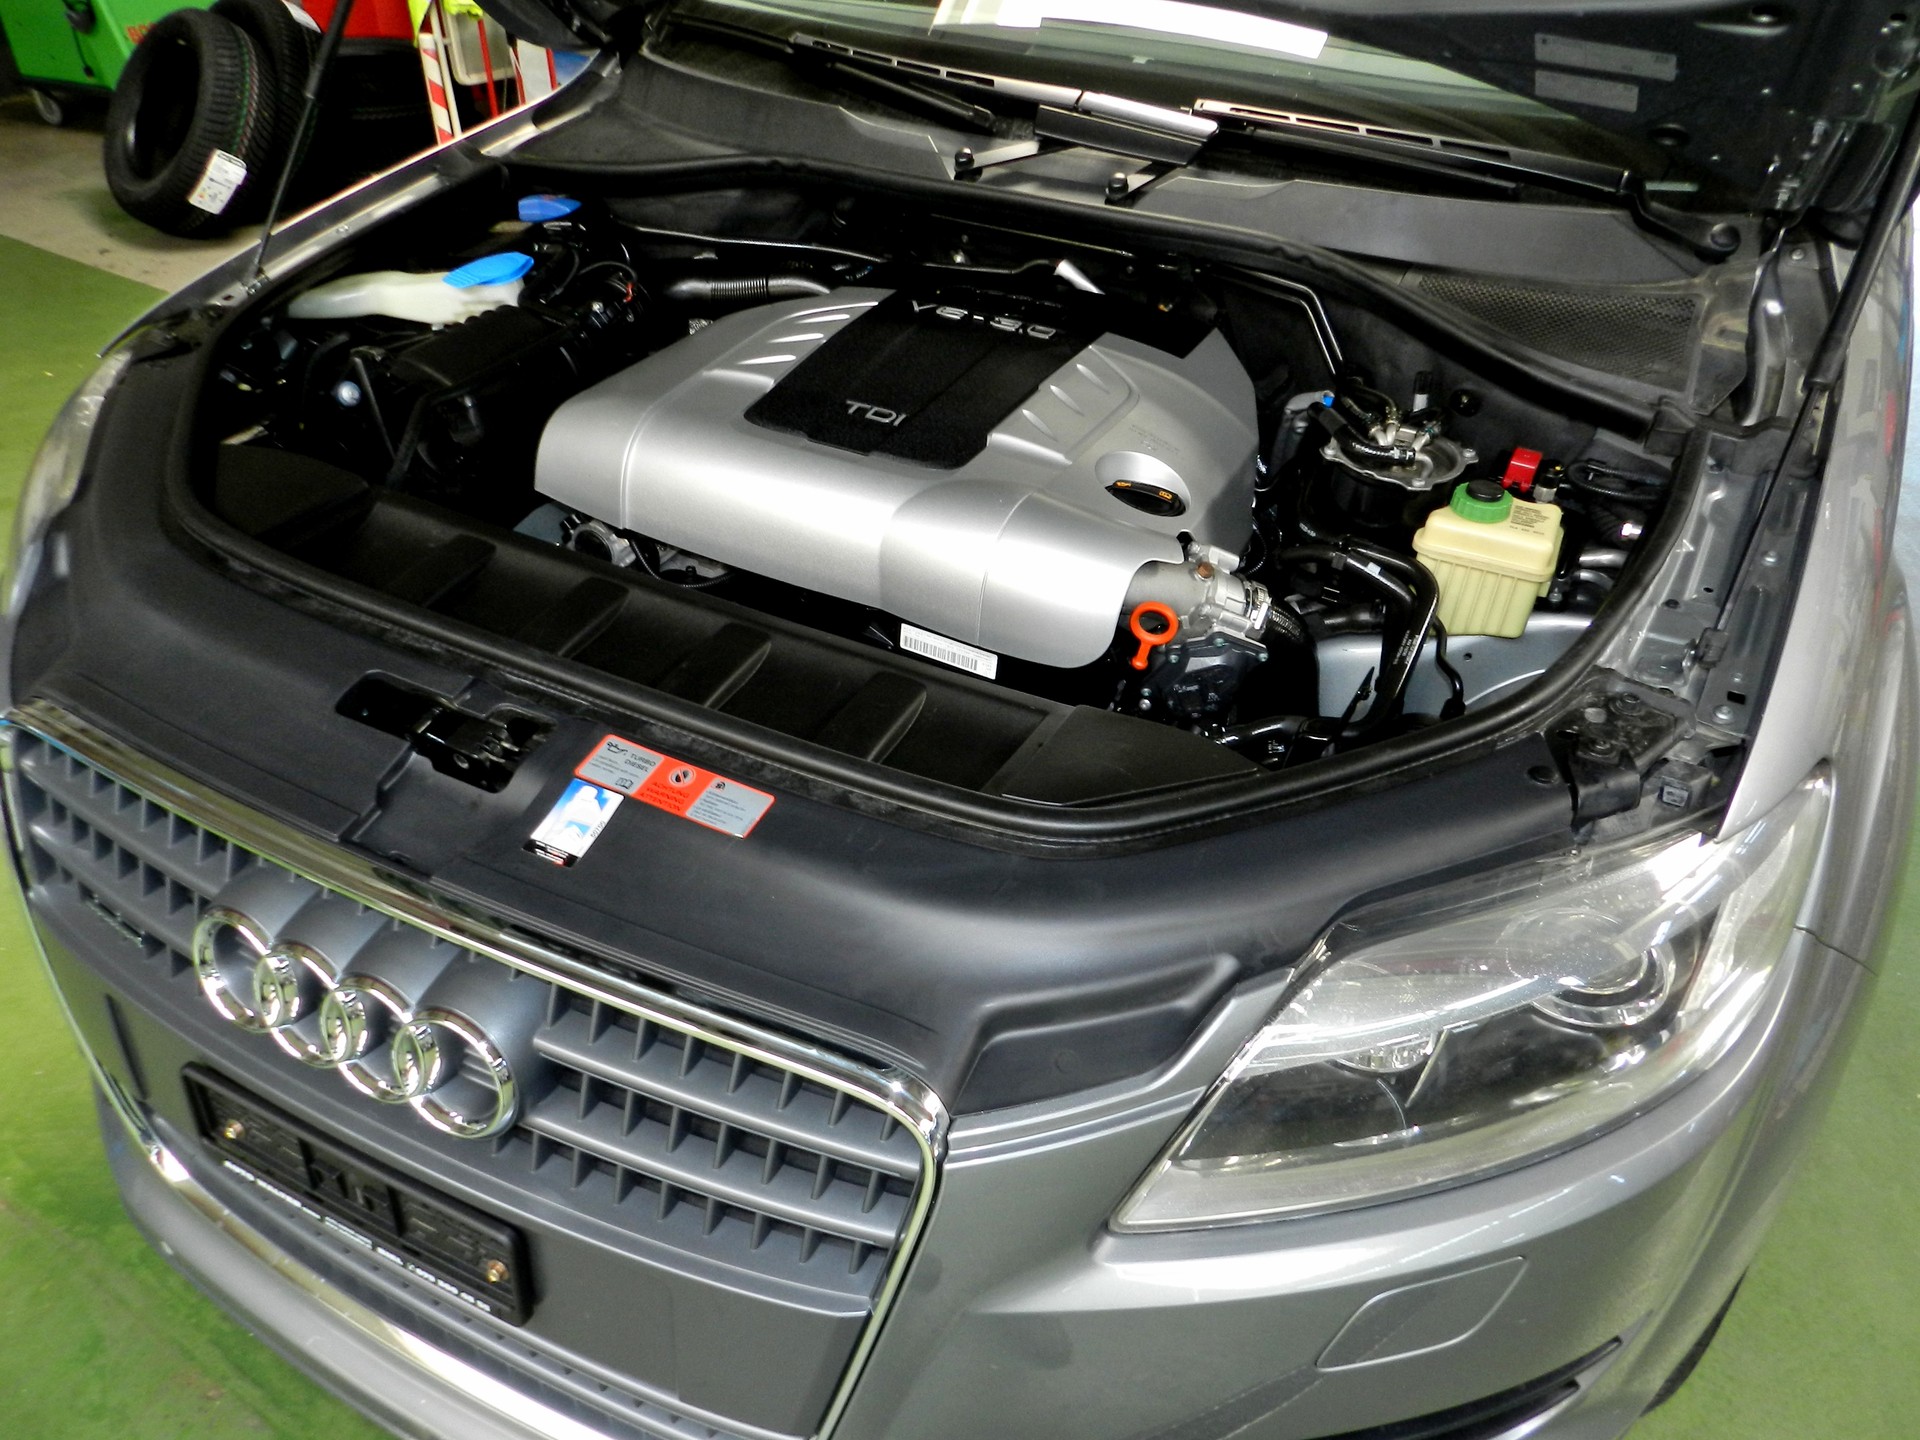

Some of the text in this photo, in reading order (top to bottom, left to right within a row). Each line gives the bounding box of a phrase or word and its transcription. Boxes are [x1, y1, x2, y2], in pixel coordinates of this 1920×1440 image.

[846, 400, 907, 427] TDI
[624, 758, 649, 773] DIESEL
[630, 752, 657, 767] TURBO
[640, 791, 681, 812] ATTENTION
[646, 786, 685, 805] WARNING
